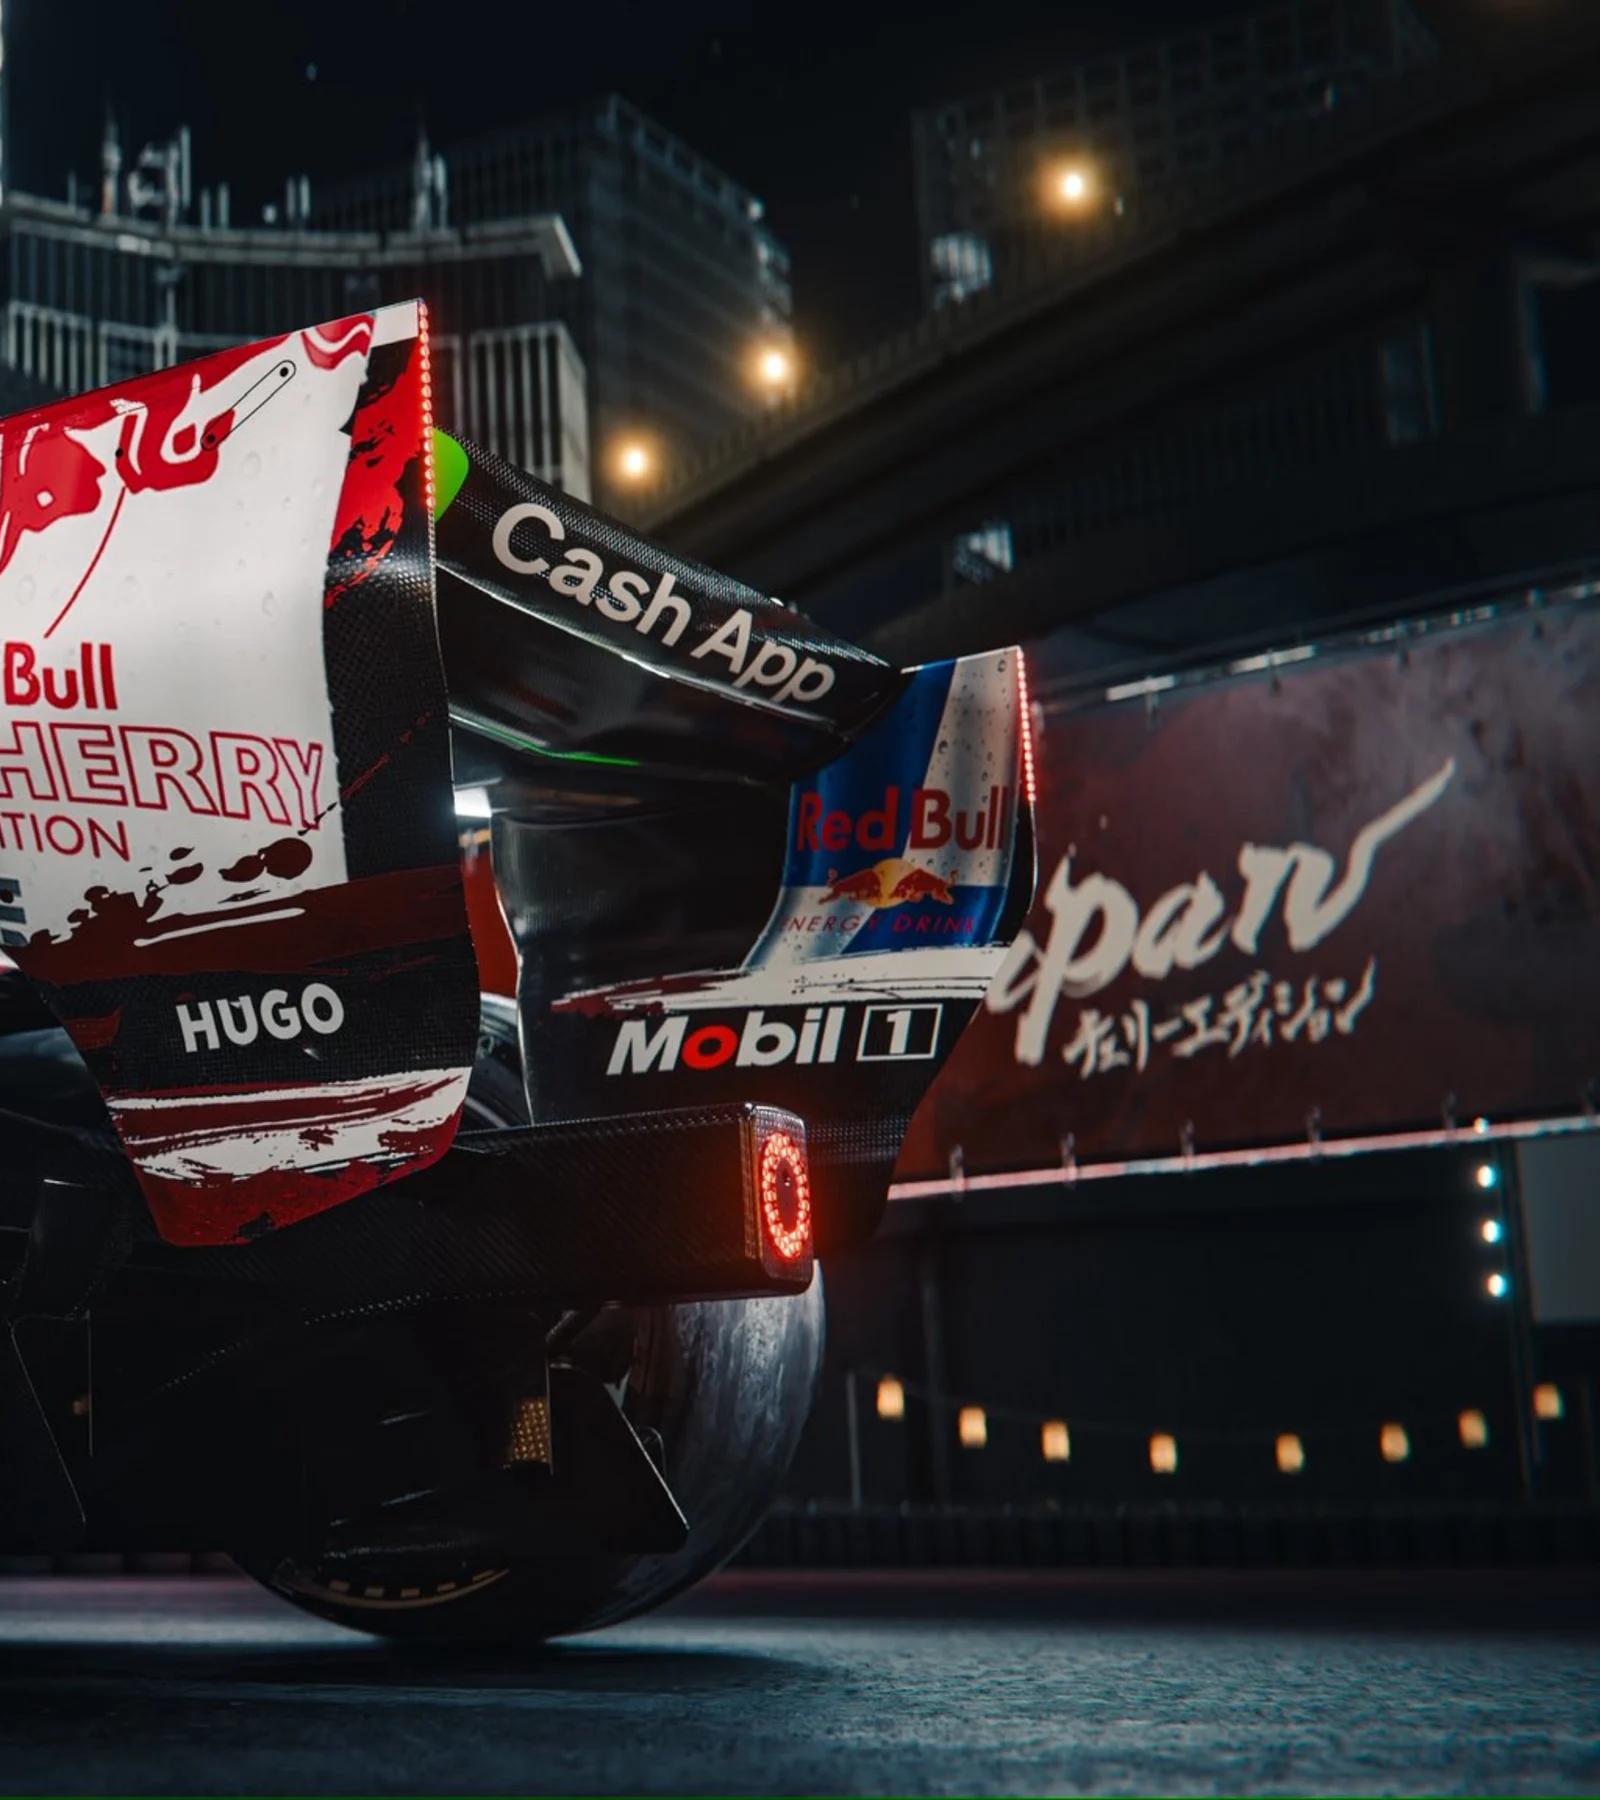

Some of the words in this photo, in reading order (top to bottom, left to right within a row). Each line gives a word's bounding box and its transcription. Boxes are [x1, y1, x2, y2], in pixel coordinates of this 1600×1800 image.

[491, 501, 693, 648] Cash
[690, 608, 837, 703] App
[4, 641, 119, 711] Bull
[796, 784, 900, 850] Red
[909, 785, 1009, 850] Bull
[778, 914, 883, 933] ENERGY
[891, 914, 977, 934] DRINK
[983, 756, 1457, 1067] pan
[174, 981, 346, 1054] HUGO
[605, 1005, 845, 1077] Mobil
